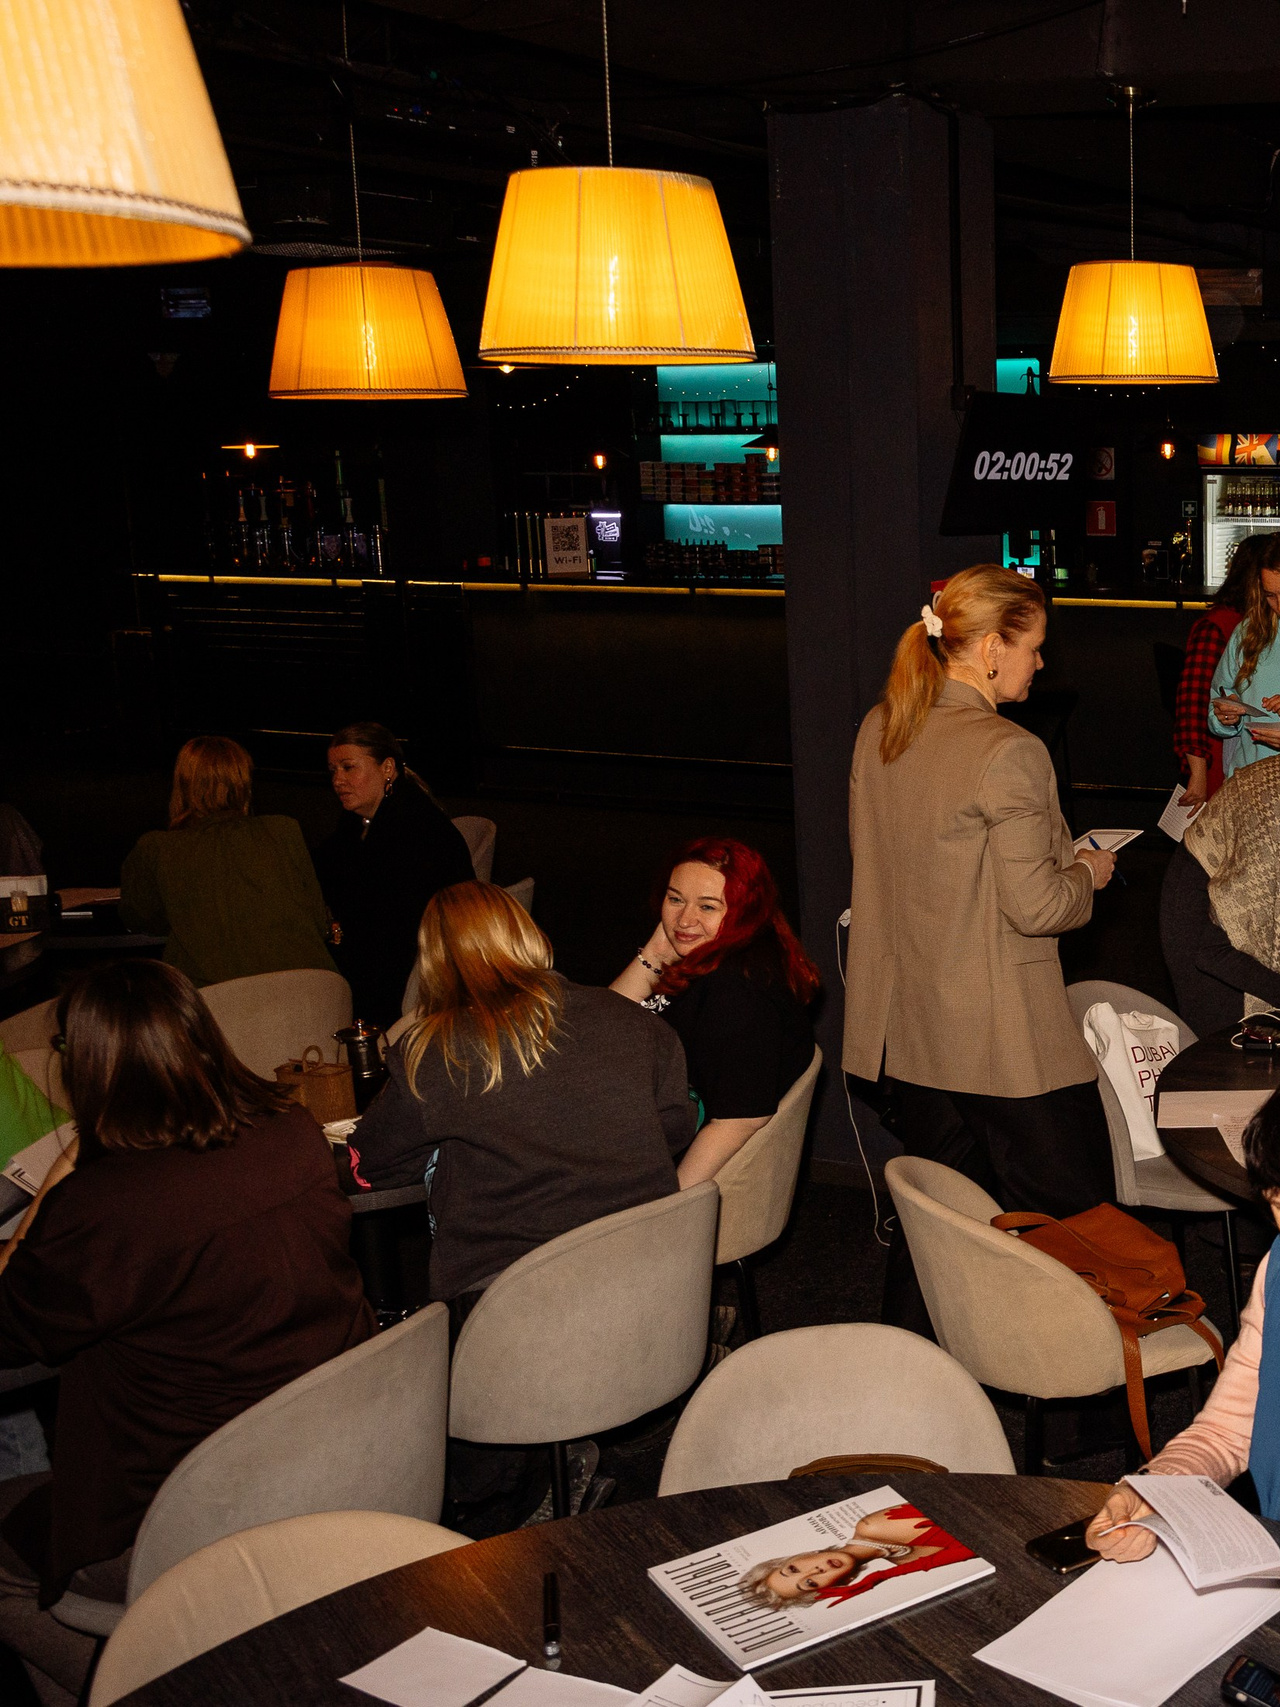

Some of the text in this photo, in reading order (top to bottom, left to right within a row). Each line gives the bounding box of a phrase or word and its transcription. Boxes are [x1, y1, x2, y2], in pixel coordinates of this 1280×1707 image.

[973, 450, 1074, 481] 02:00:52
[554, 555, 582, 565] Wi-Fi
[8, 915, 29, 927] GT
[1131, 1041, 1178, 1064] DUBAI
